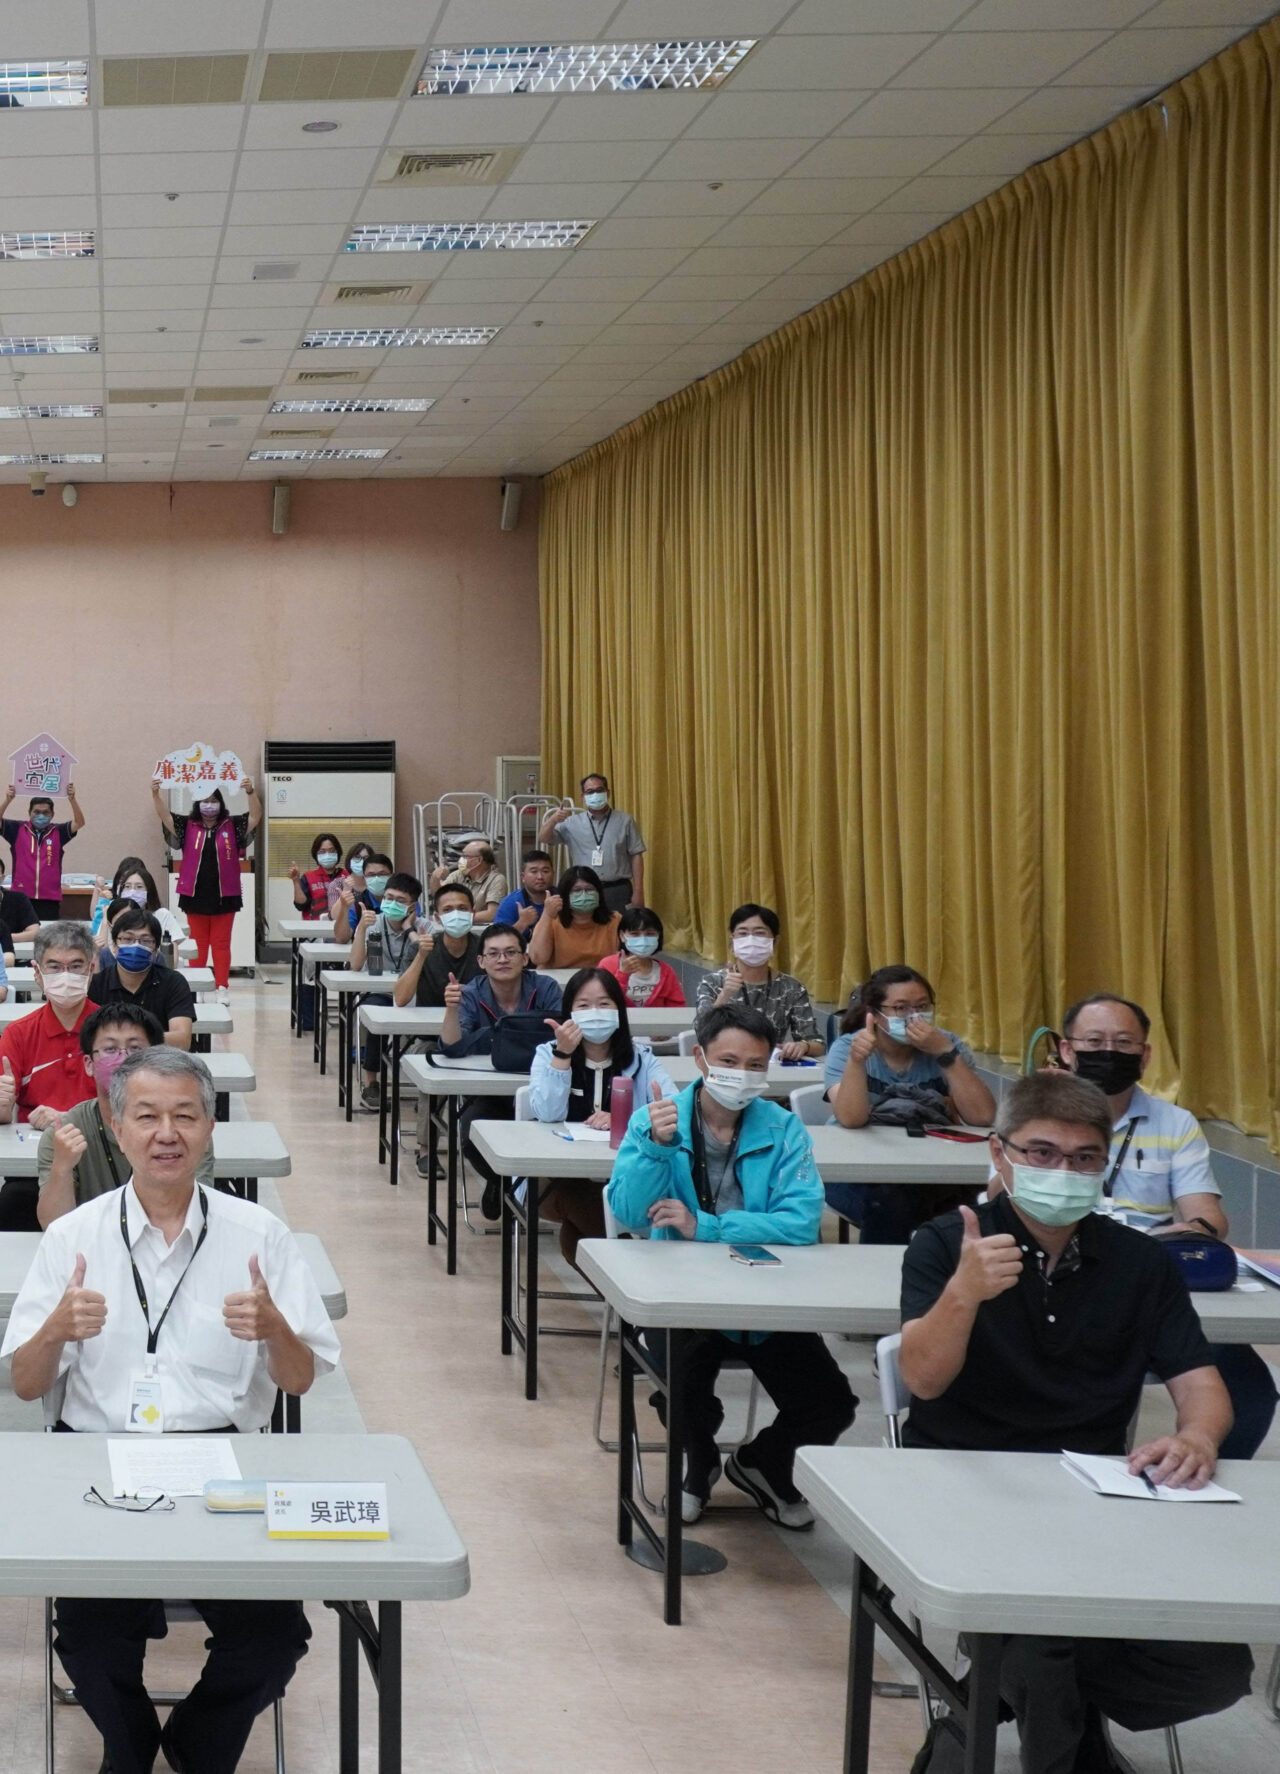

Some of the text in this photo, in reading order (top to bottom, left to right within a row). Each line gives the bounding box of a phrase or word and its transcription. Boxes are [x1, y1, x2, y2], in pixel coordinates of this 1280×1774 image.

[24, 752, 61, 772] 世代
[153, 759, 239, 783] 廉潔嘉義
[25, 772, 60, 791] 宜居
[310, 1500, 381, 1524] 吳武璋
